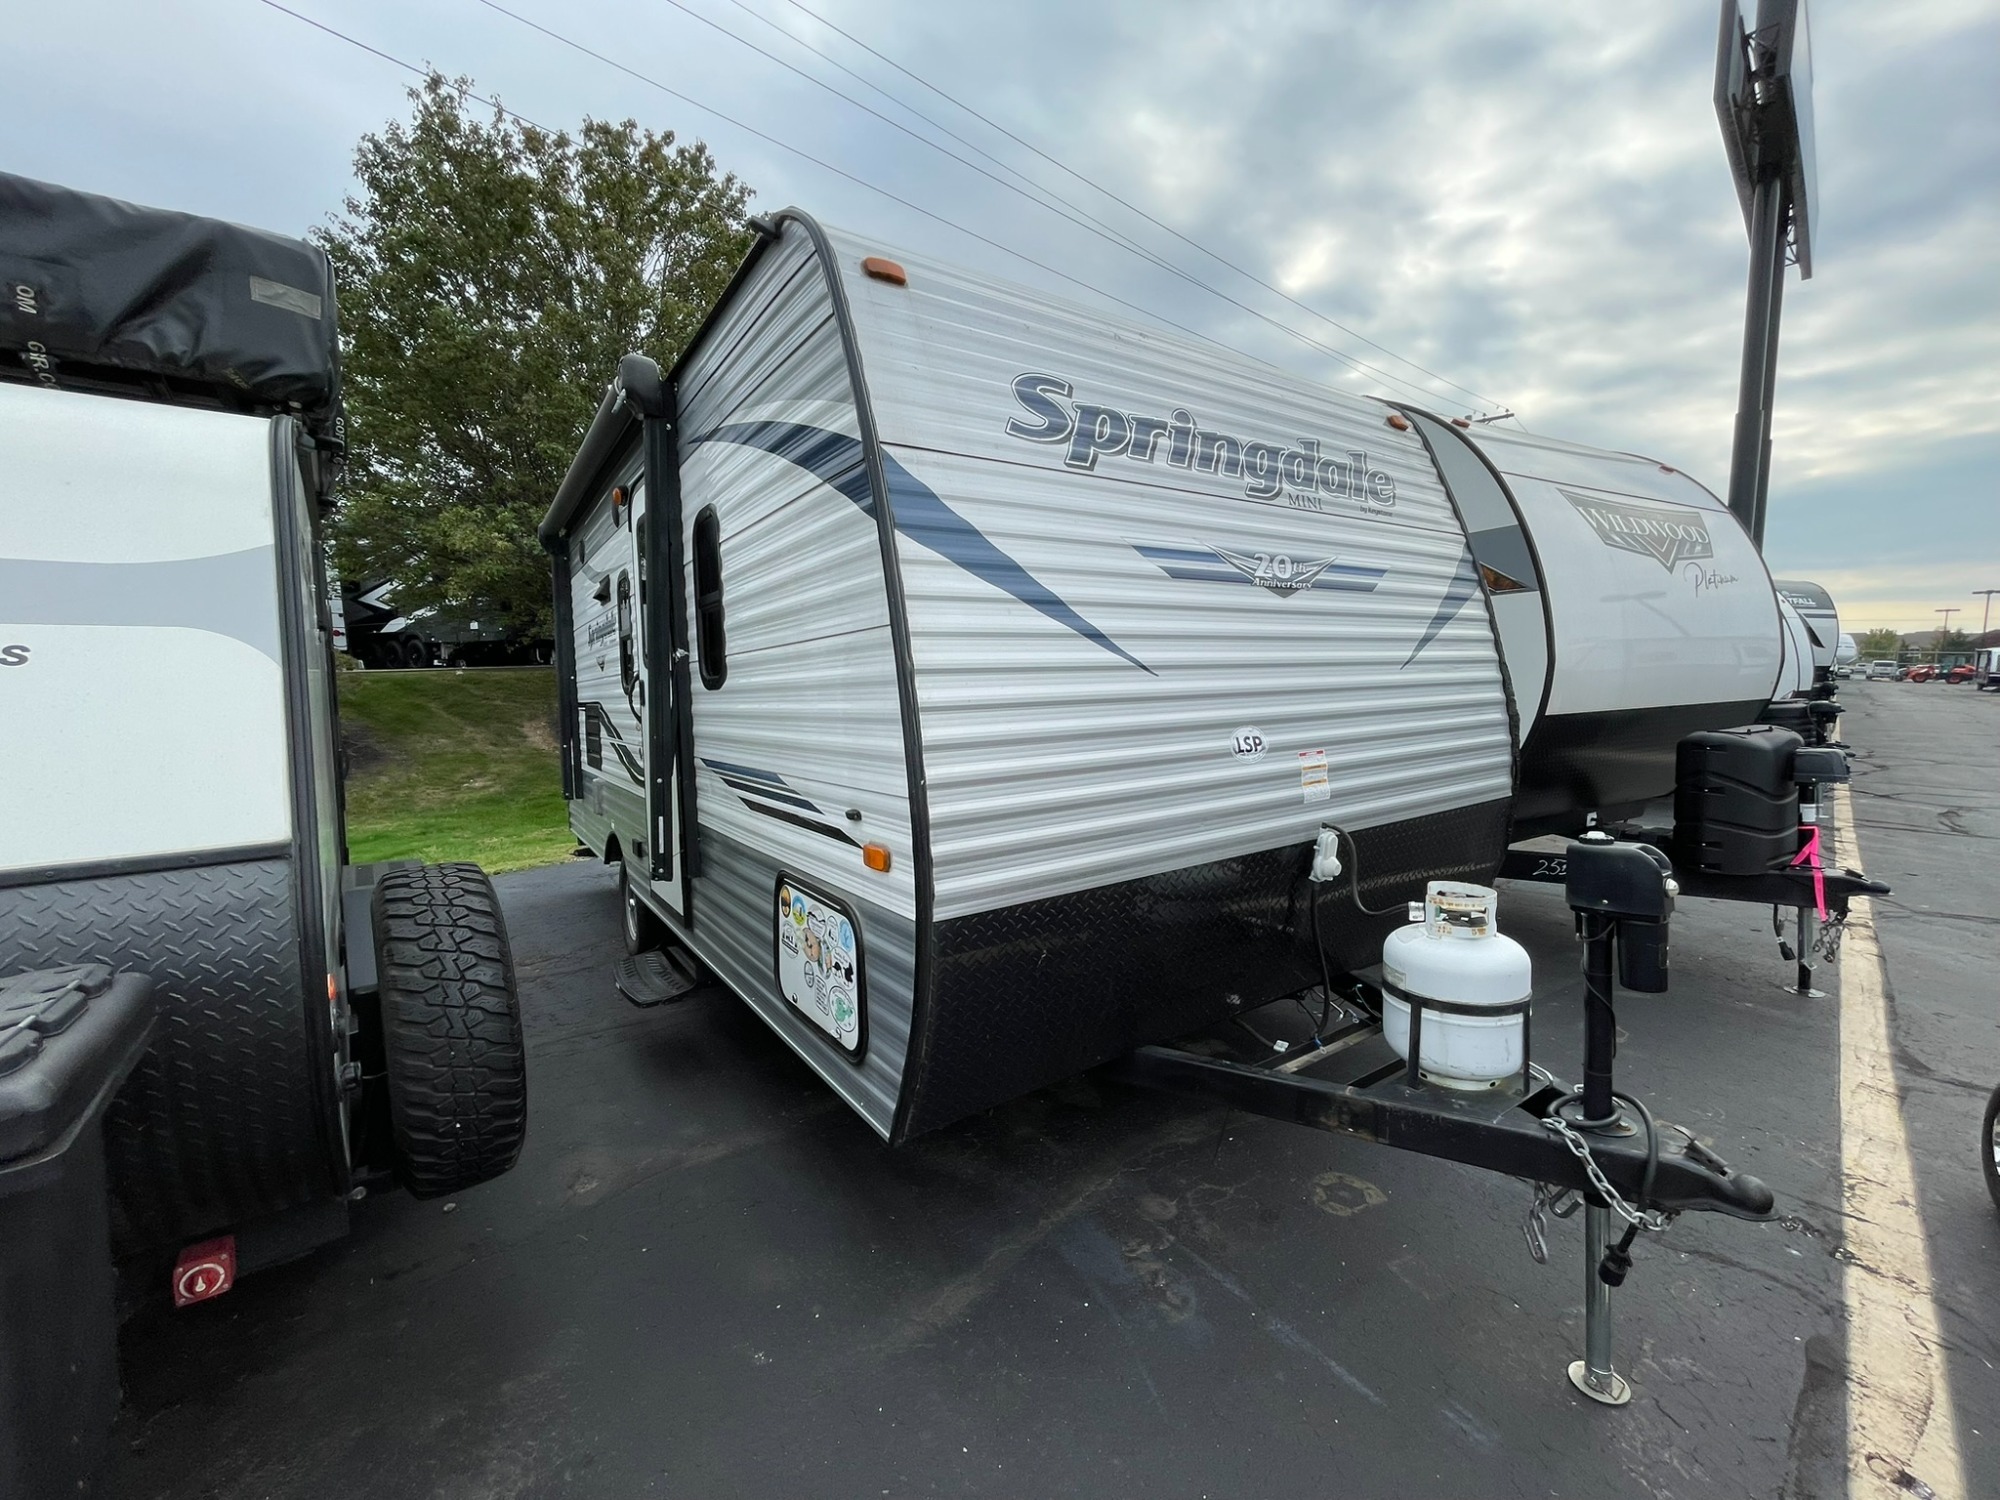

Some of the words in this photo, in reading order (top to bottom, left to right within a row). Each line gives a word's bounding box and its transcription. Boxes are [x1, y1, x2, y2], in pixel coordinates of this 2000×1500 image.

[1005, 372, 1397, 507] Springdale
[1287, 491, 1323, 511] MINI
[1577, 506, 1709, 544] WILDWOOD
[1252, 577, 1313, 592] Anniversary
[1235, 735, 1263, 754] LSP
